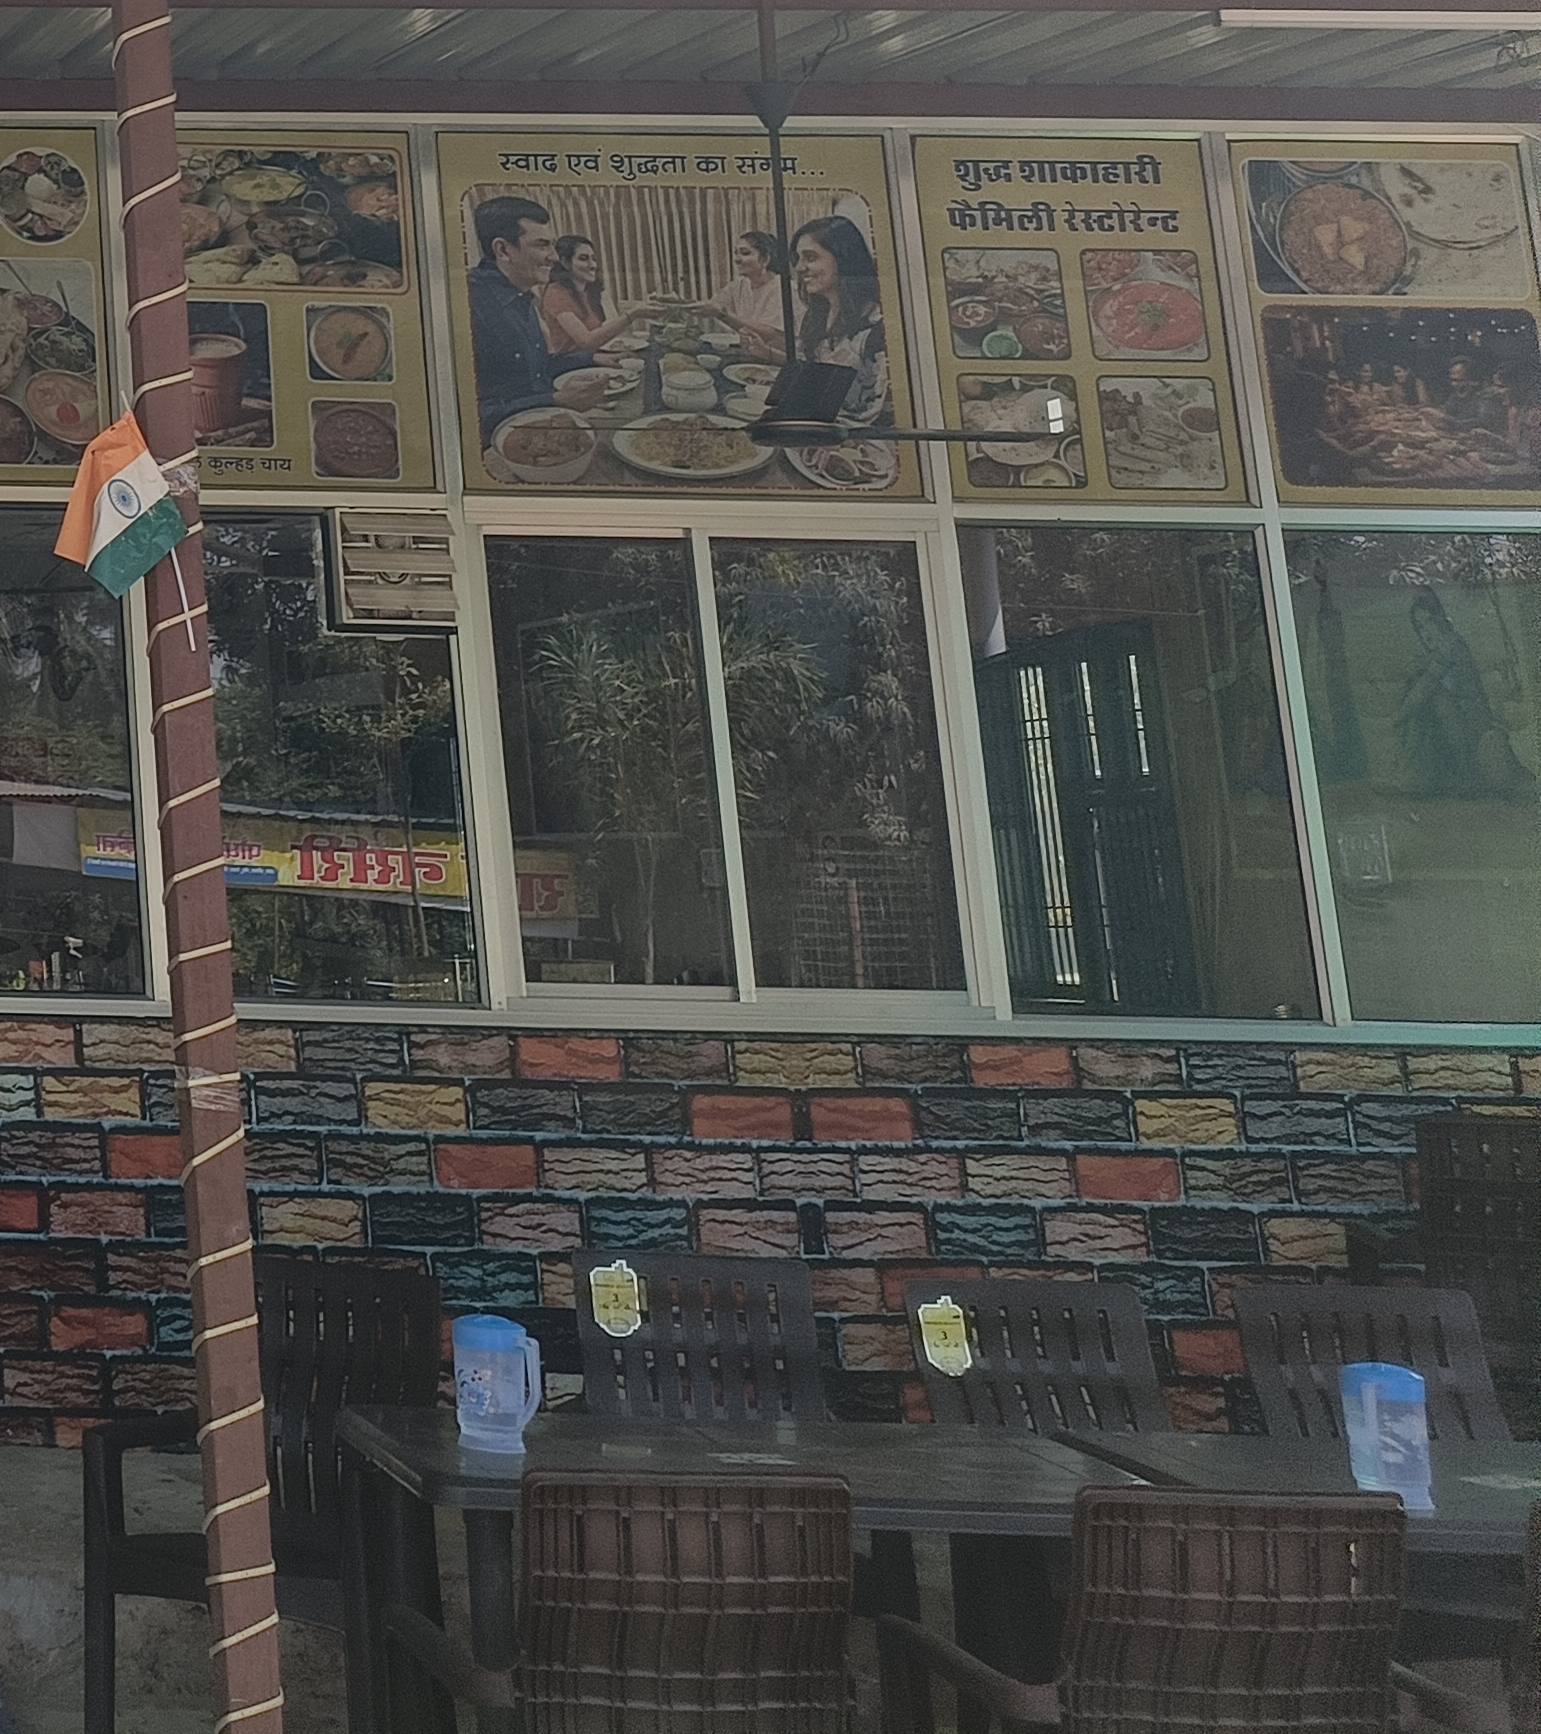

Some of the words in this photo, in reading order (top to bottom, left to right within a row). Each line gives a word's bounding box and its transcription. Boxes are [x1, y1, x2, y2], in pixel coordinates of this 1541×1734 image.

[498, 150, 558, 173] स्वाद
[565, 146, 602, 174] एवं
[610, 151, 687, 181] शुद्धता
[696, 152, 727, 175] का
[952, 157, 1014, 189] शुद्ध
[1019, 153, 1163, 185] शाकाहारी
[947, 200, 1058, 233] फैमिली
[207, 455, 256, 477] कुल्हड़
[260, 455, 293, 474] चाय
